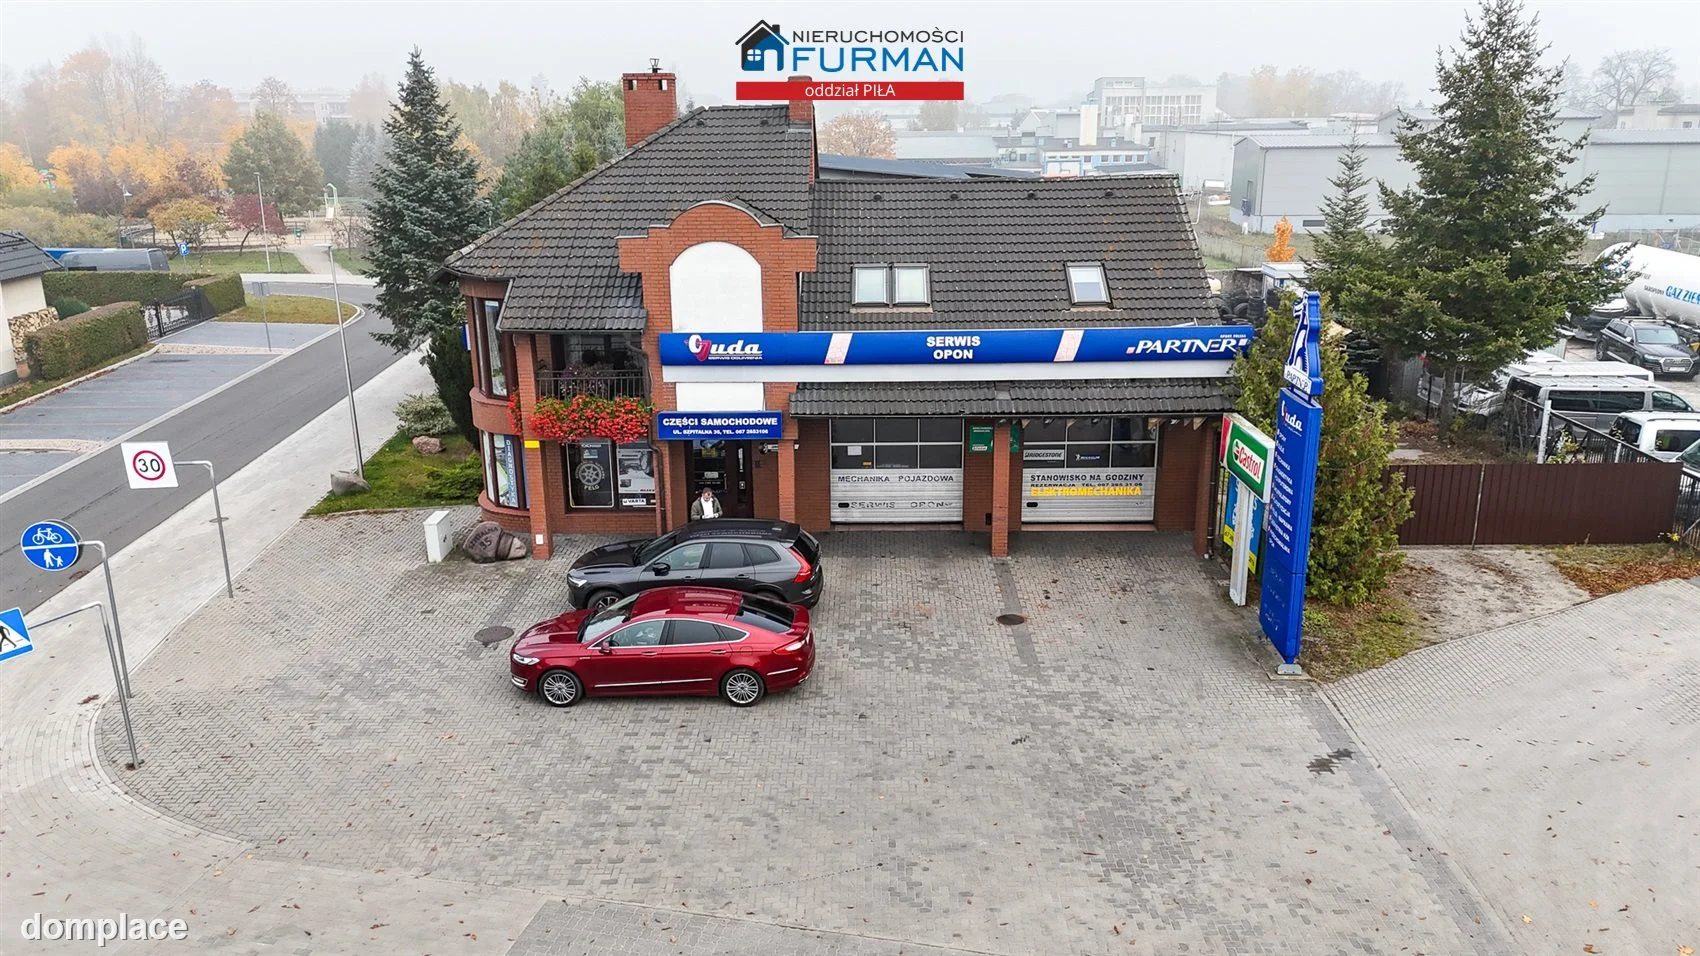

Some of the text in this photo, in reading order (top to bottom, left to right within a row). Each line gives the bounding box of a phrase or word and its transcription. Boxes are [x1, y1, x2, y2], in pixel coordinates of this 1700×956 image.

[181, 244, 187, 254] P
[1666, 285, 1682, 301] GAZ
[926, 335, 981, 347] SERWIS
[1135, 338, 1238, 354] PARTNER
[933, 349, 973, 360] OPON
[662, 416, 778, 428] CZĘŚCI SAMOCHODOWE
[138, 458, 161, 473] 30
[1239, 446, 1262, 480] Castrol
[1030, 474, 1087, 482] STANOWISKO
[1105, 473, 1145, 481] GODZINY
[1031, 486, 1142, 497] ELEKTROMECHANIKA
